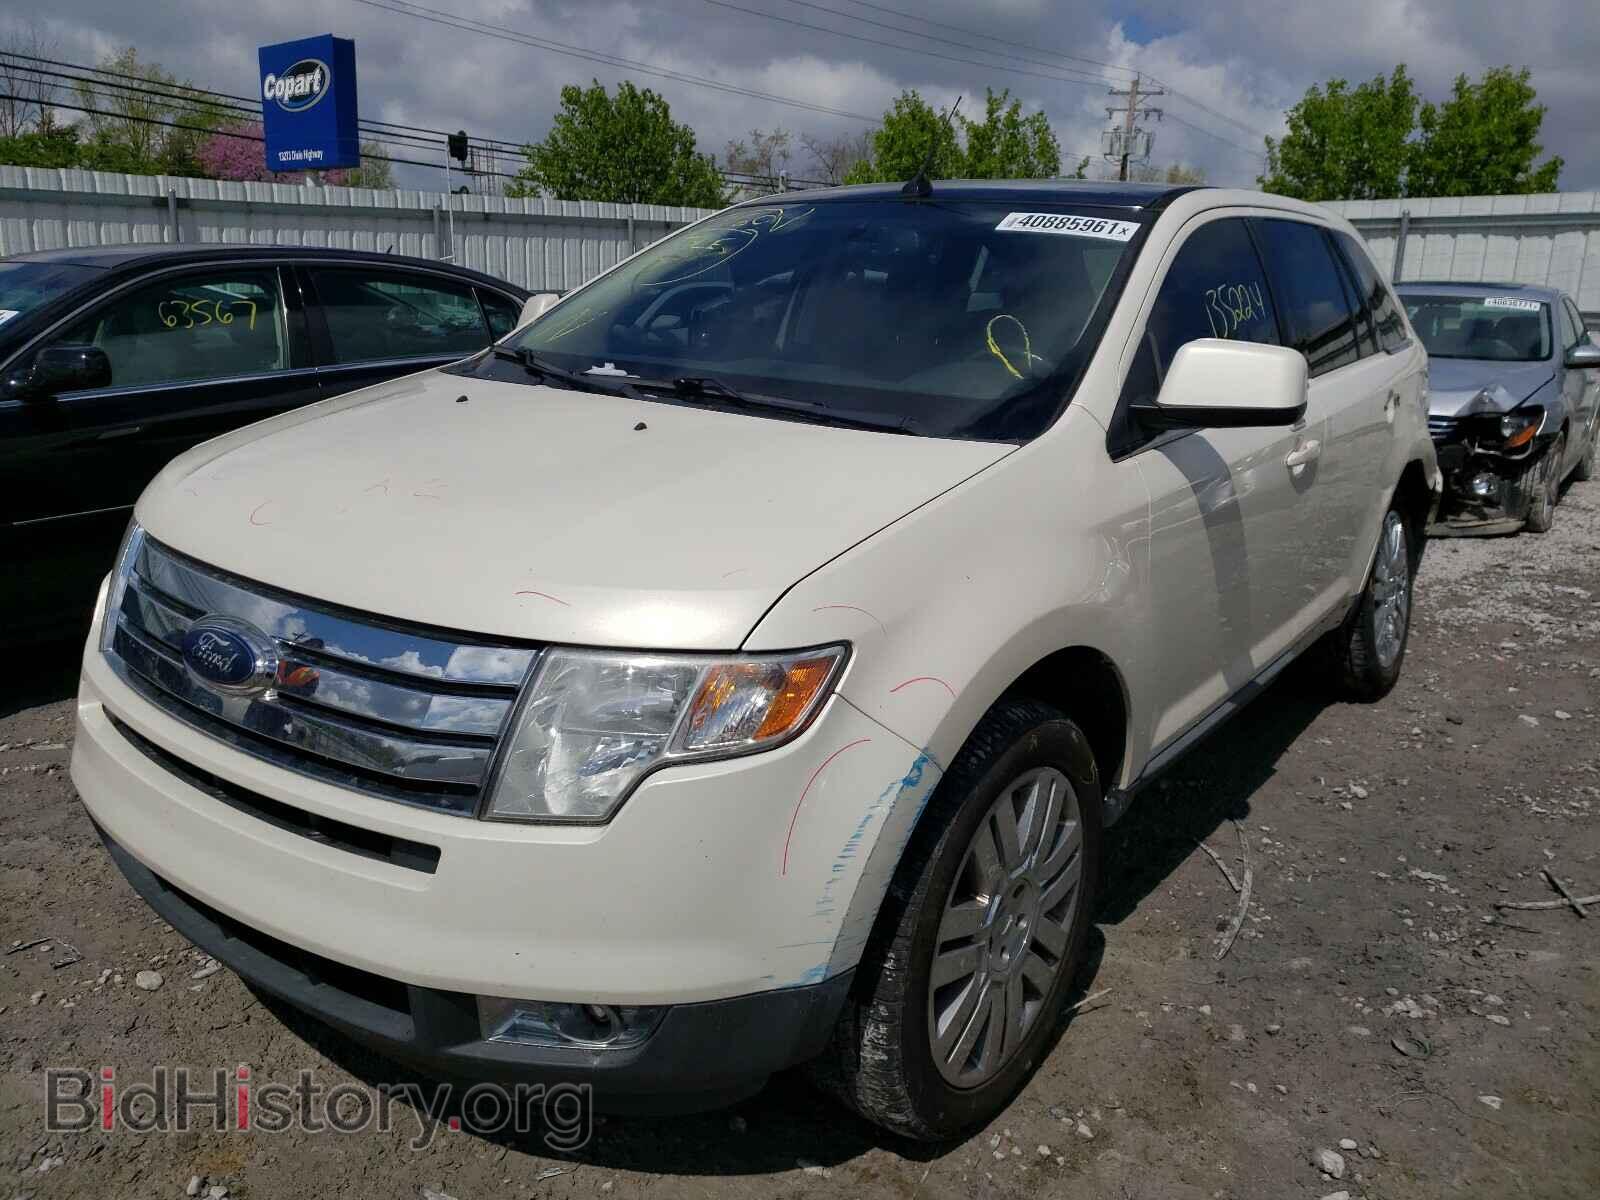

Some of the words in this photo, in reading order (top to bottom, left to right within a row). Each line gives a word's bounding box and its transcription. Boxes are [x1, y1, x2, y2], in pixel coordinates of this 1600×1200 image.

[264, 65, 321, 104] Copart
[303, 148, 324, 162] Highway
[1018, 214, 1120, 235] 40885961
[159, 300, 256, 331] 63567
[192, 631, 240, 673] Ford
